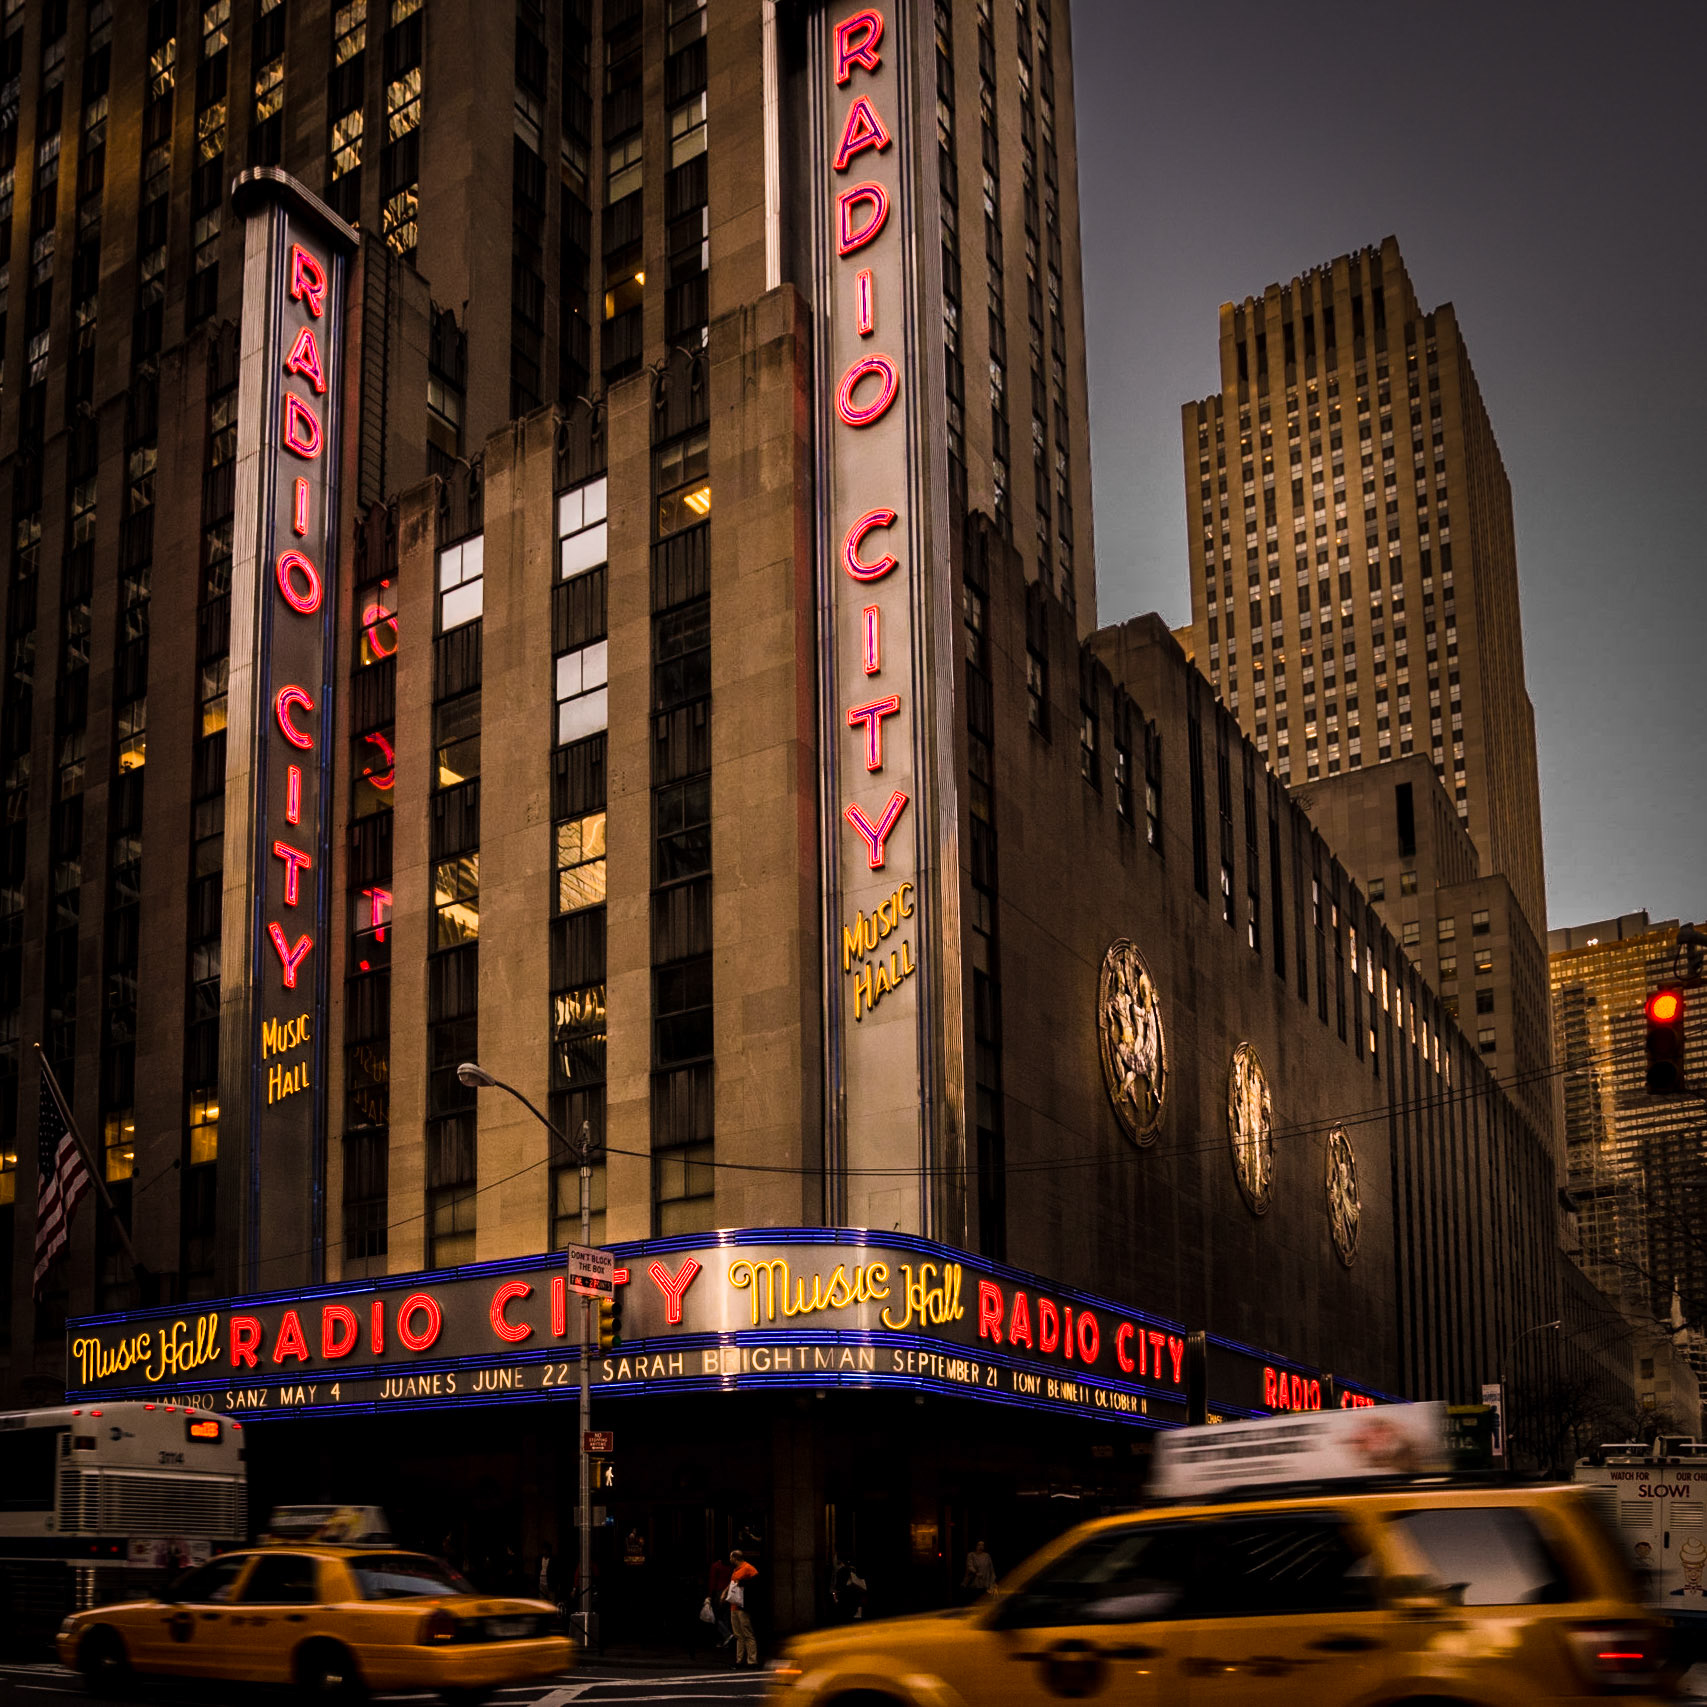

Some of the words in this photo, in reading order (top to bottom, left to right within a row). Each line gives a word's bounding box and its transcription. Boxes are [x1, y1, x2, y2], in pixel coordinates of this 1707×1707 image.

[833, 8, 900, 427] RADIO
[276, 242, 328, 614] RADIO
[842, 508, 908, 869] CITY
[268, 684, 315, 989] CITY
[843, 881, 914, 973] MUSIC
[854, 940, 915, 1020] HALL
[262, 1013, 310, 1060] MUSIC
[268, 1061, 310, 1104] HALL
[571, 1250, 590, 1261] DON'T
[591, 1255, 612, 1266] BLOCK
[579, 1262, 591, 1272] THE
[592, 1265, 605, 1274] BOX
[230, 1292, 442, 1368] RADIO
[490, 1257, 701, 1342] CIY
[882, 1263, 964, 1330] Hall
[146, 1313, 220, 1382] Hall
[979, 1280, 1100, 1364] RADIO
[1116, 1322, 1184, 1384] CITY
[226, 1388, 268, 1409] SANZ
[280, 1385, 317, 1405] MAY
[330, 1382, 341, 1401] 4
[380, 1373, 457, 1398] JUANES
[472, 1367, 525, 1391] JUNE
[542, 1363, 568, 1386] 22
[602, 1352, 683, 1381] SARAH
[703, 1347, 875, 1374] BRIGHTMAN
[893, 1349, 979, 1384] SEPTEMBER
[986, 1366, 998, 1387] 21
[1012, 1371, 1041, 1394] TONY
[1095, 1388, 1137, 1412] OCTOBER
[1264, 1366, 1321, 1411] RADIO
[158, 1451, 185, 1465] 3114
[1610, 1472, 1634, 1480] WATCH
[1636, 1472, 1649, 1480] FOR
[1676, 1472, 1692, 1481] OUR
[1638, 1484, 1690, 1498] SLOW!
